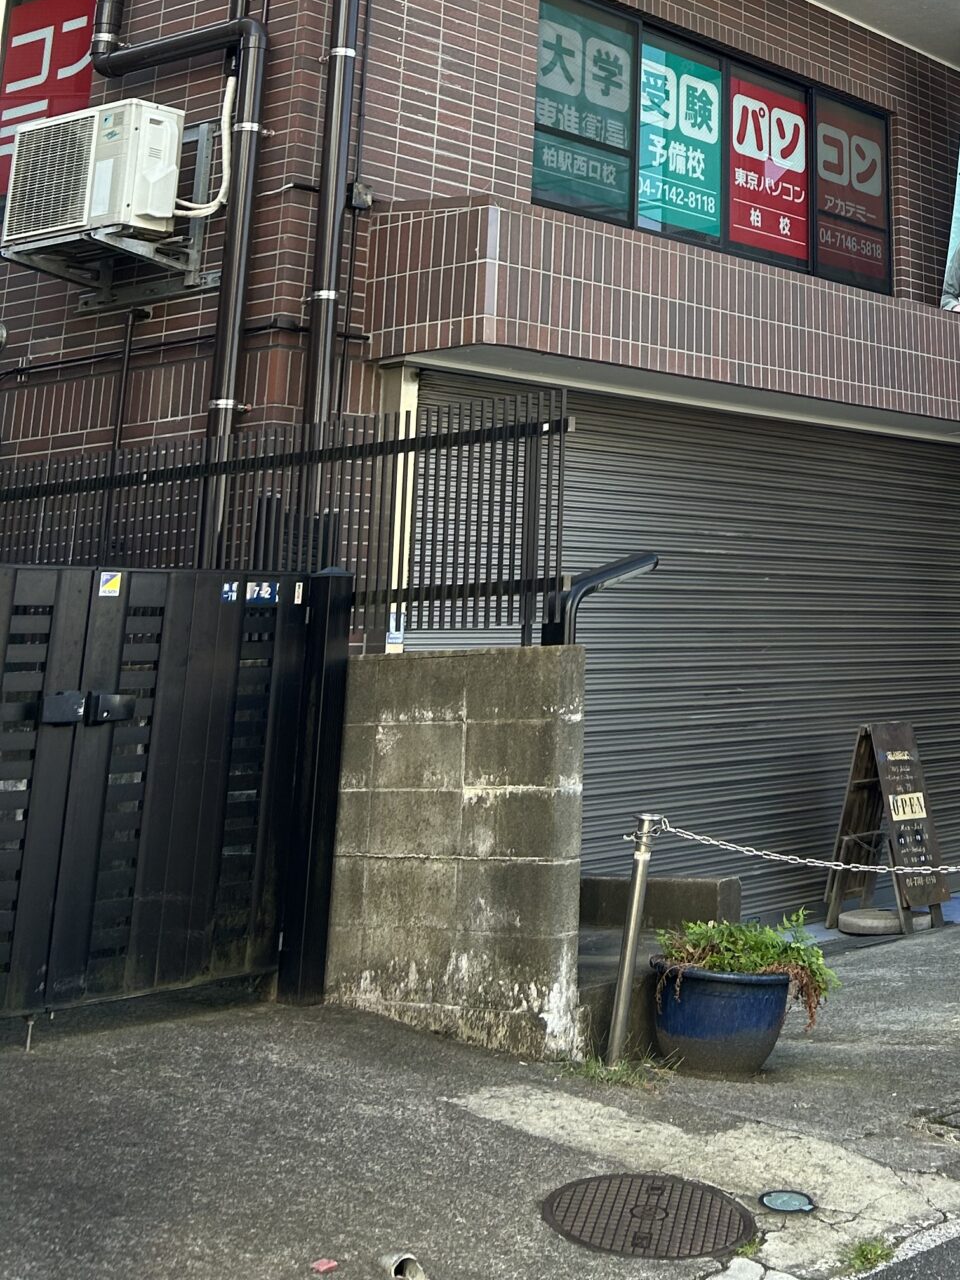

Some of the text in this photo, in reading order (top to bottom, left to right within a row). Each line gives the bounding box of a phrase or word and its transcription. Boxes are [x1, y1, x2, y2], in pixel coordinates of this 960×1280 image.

[542, 145, 616, 185] 柏駅西口校
[819, 227, 882, 259] 04-7146-5818
